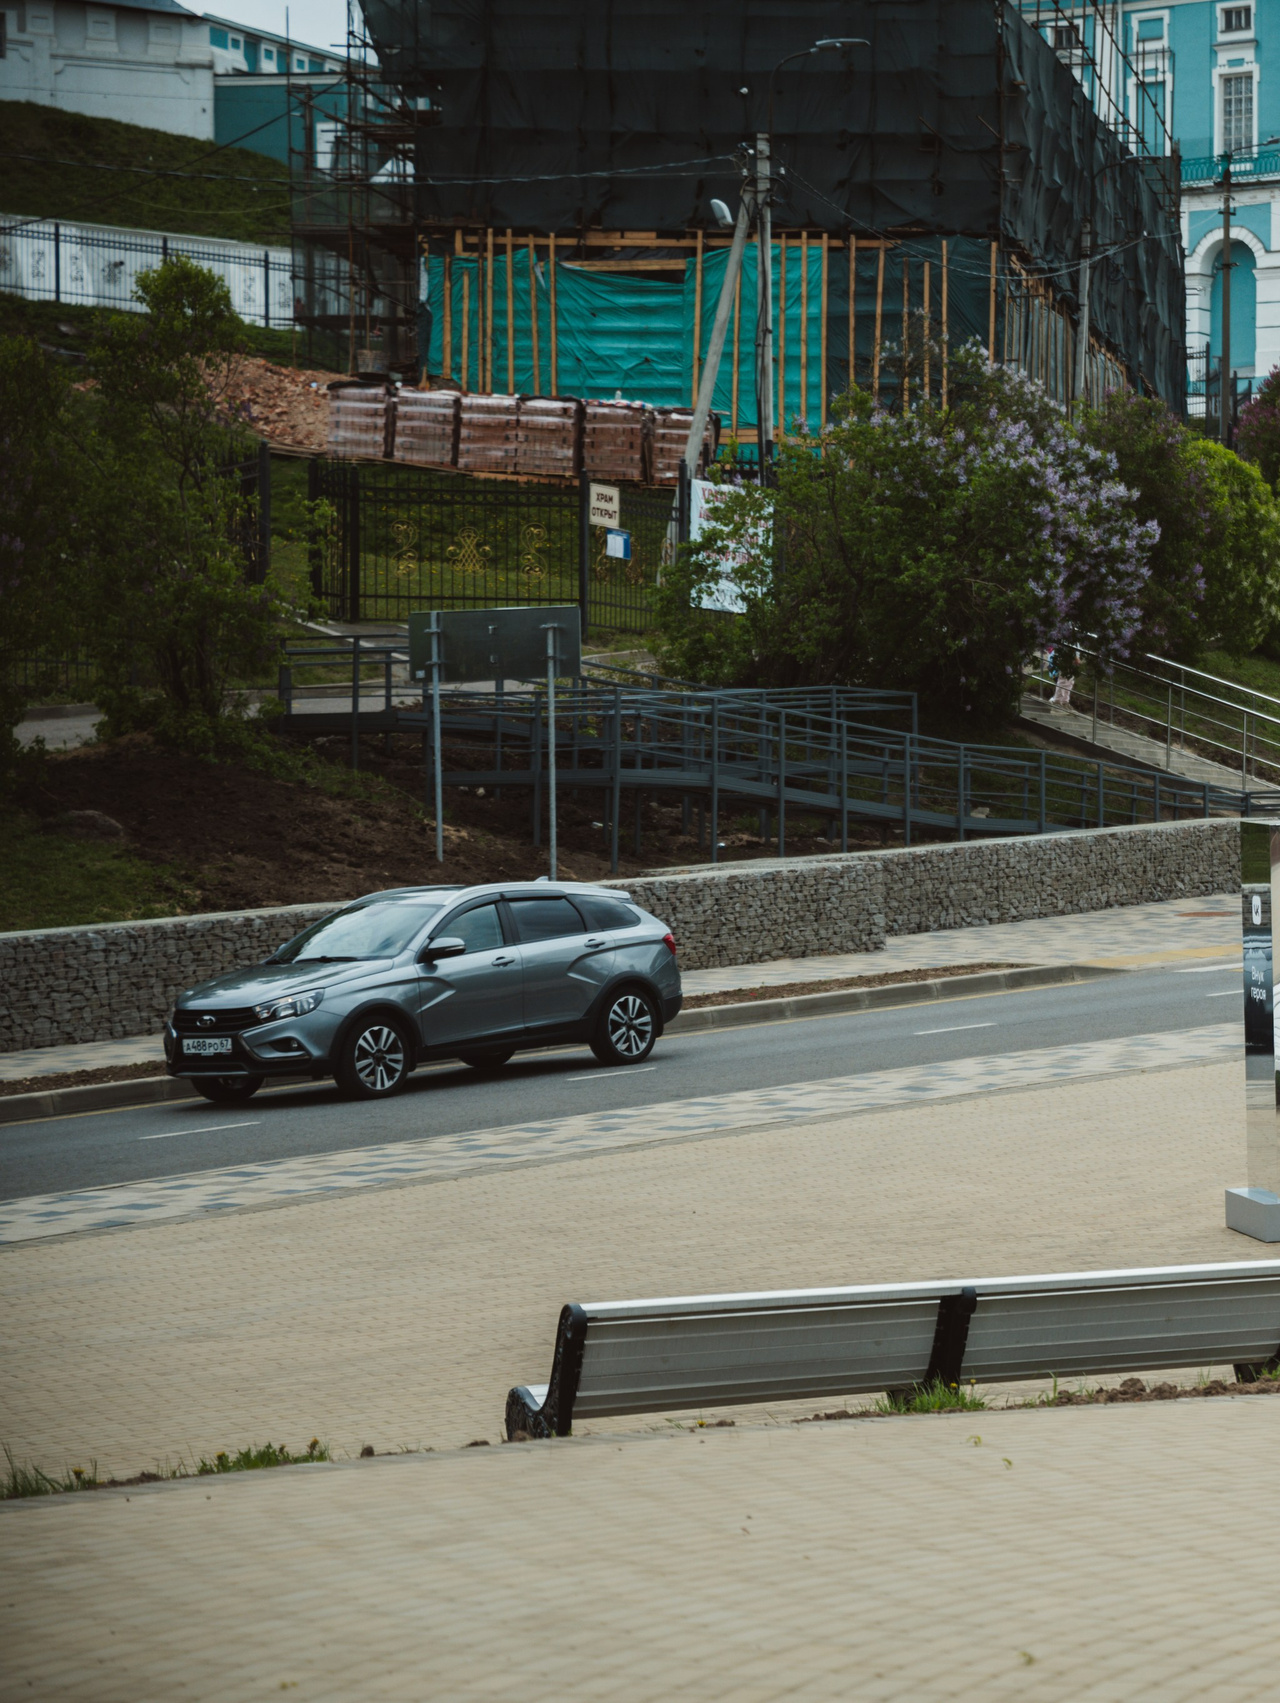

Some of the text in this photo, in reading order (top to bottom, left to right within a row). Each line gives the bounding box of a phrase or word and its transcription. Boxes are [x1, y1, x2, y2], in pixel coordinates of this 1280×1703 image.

[595, 492, 613, 504] ХРАМ
[591, 506, 617, 520] ОТКРЫТ
[1251, 965, 1265, 985] Внук
[1250, 986, 1267, 1003] героя
[186, 1039, 229, 1052] А488РО 67
